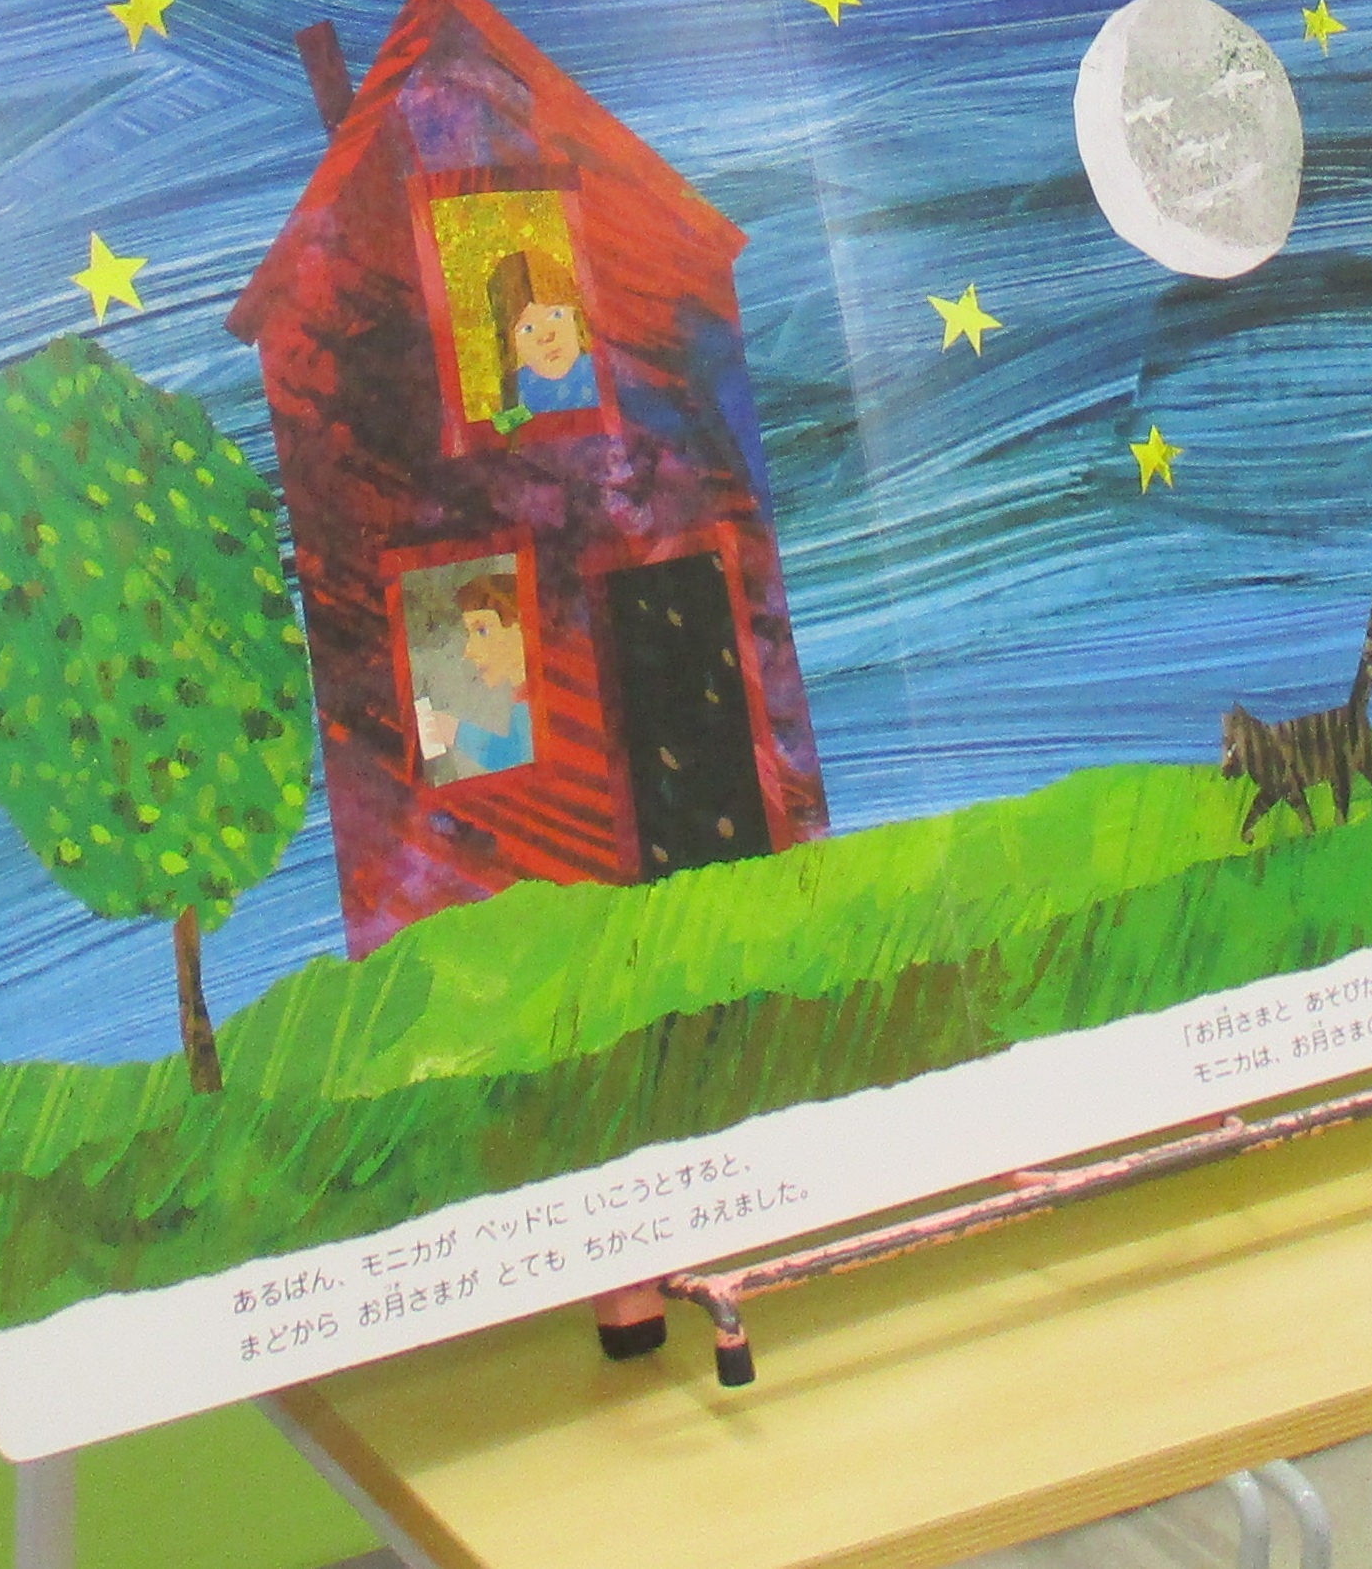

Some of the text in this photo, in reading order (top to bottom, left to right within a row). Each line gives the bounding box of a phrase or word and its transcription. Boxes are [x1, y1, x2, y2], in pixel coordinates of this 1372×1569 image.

[475, 1201, 569, 1241] ベッドに
[583, 1154, 751, 1216] いこうとすると、
[240, 1182, 809, 1362] まどから お月さまが とても ちかくに みえました。
